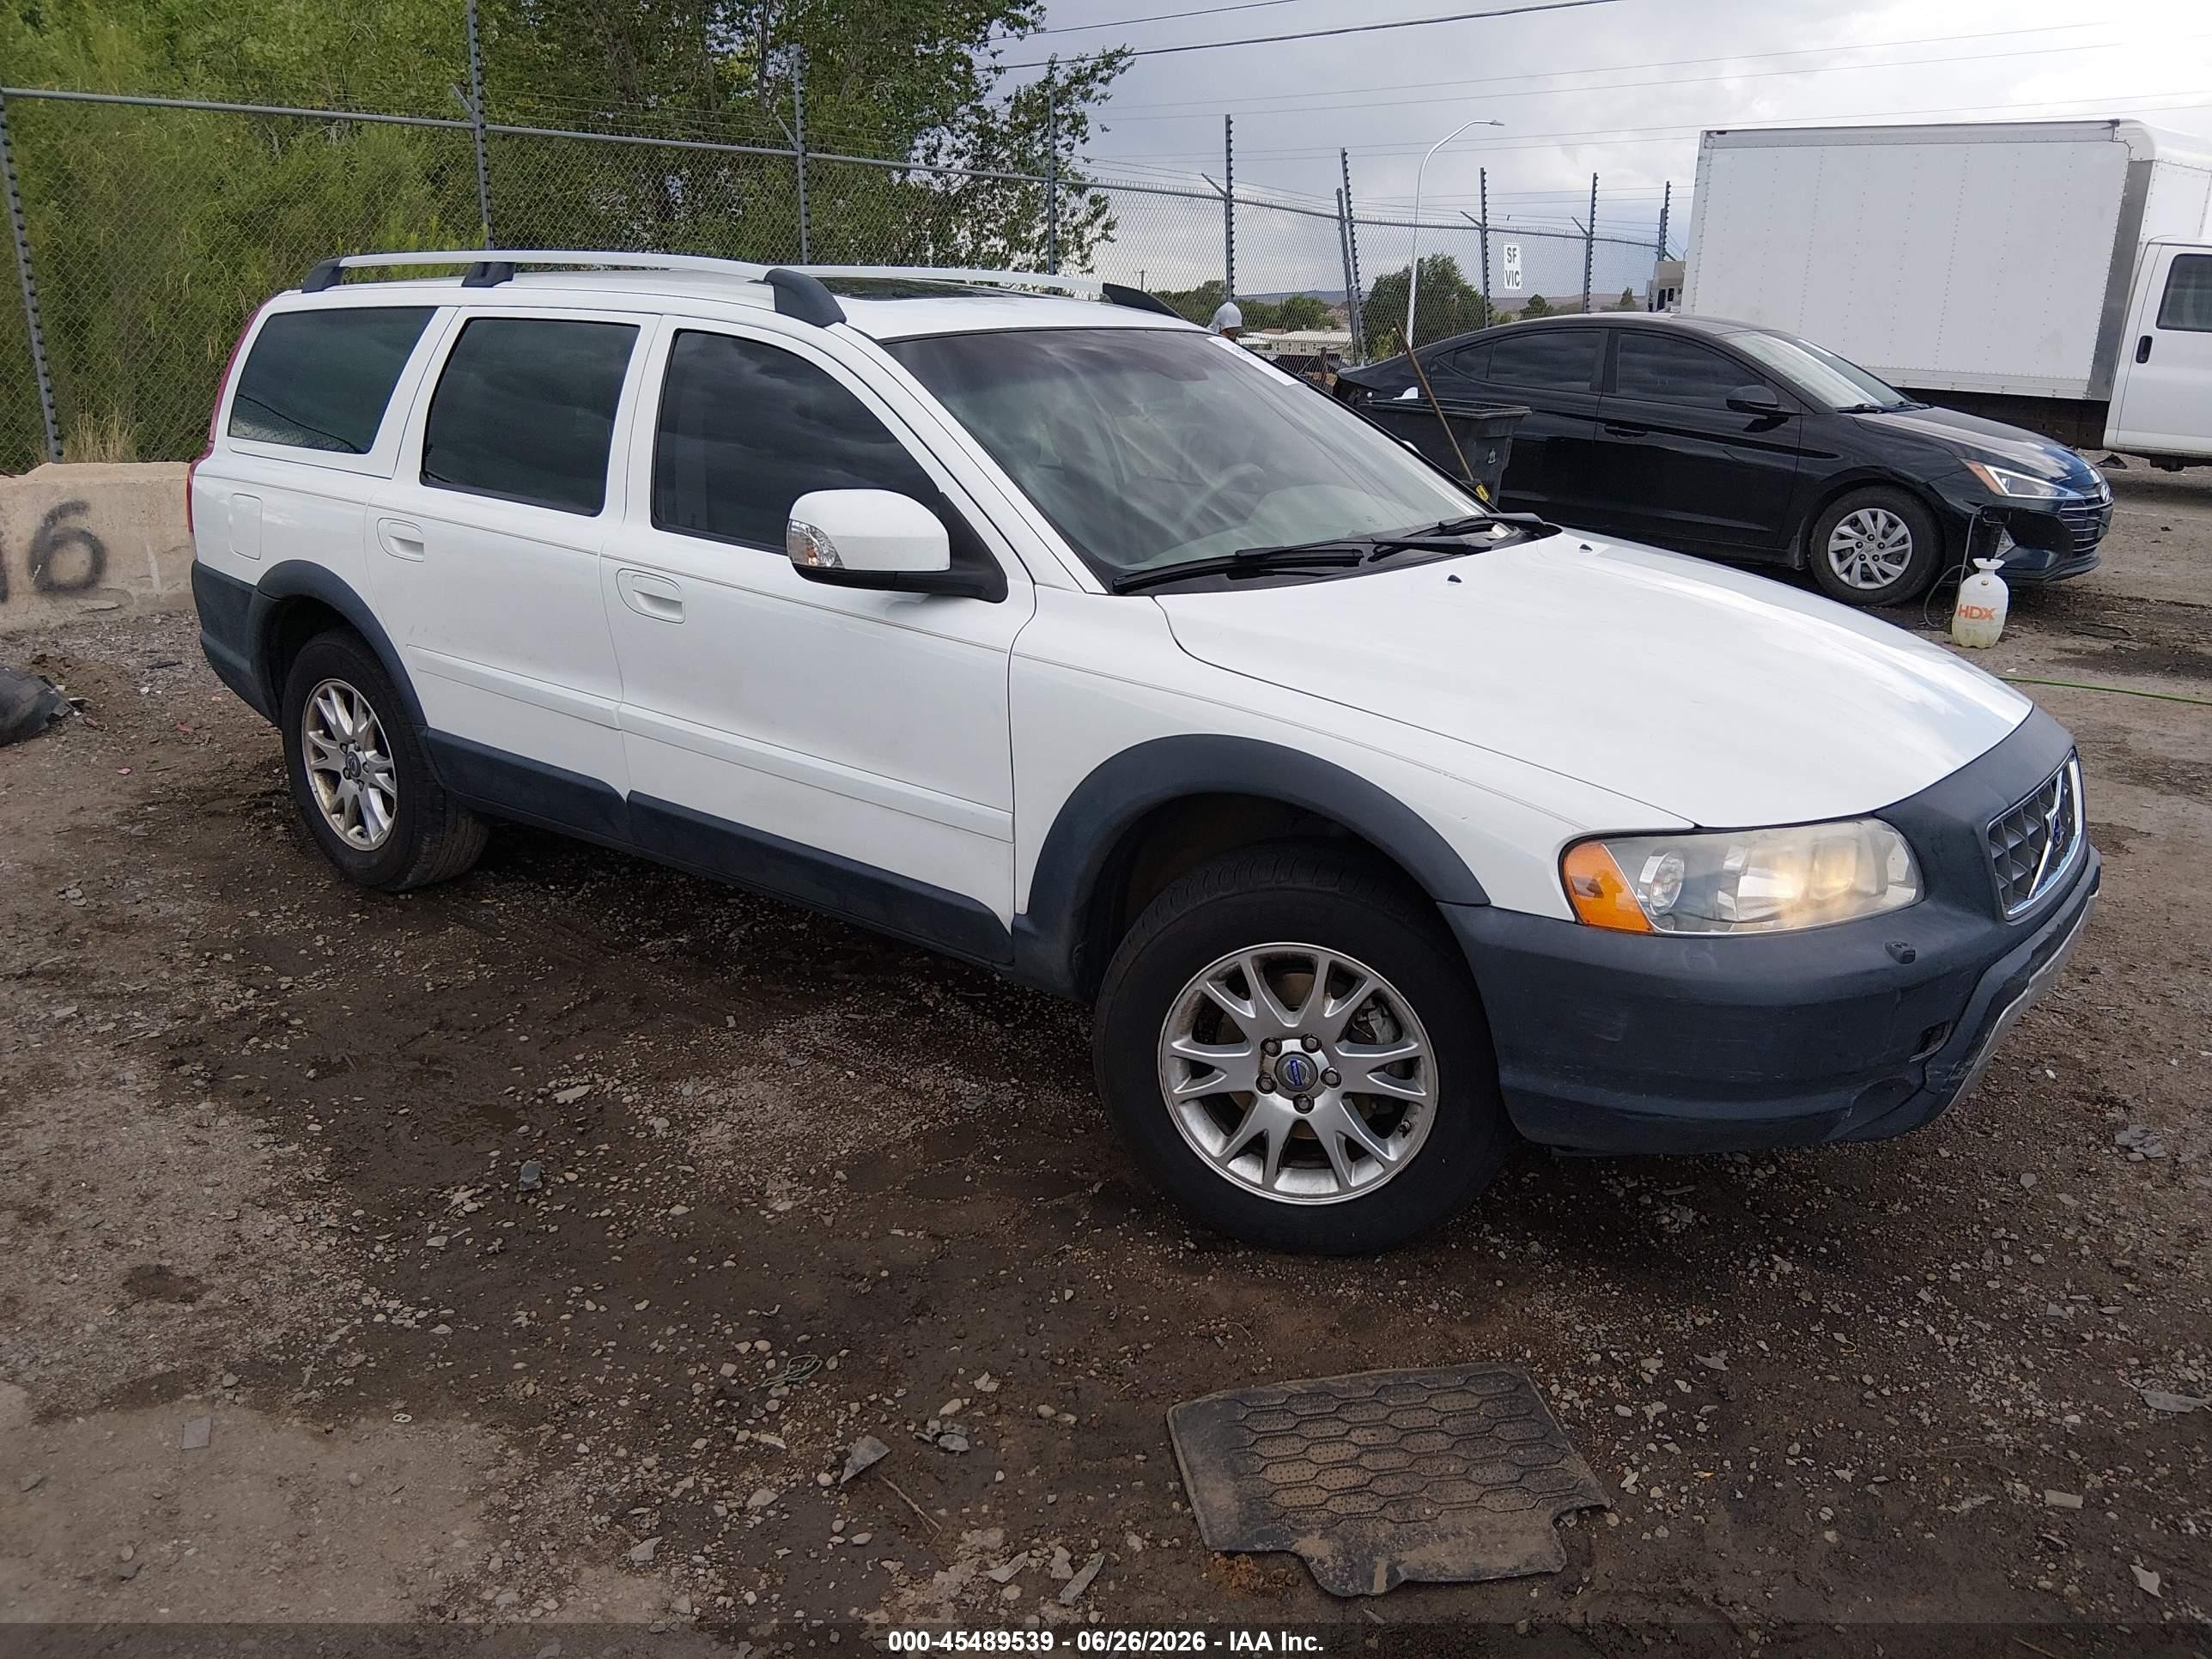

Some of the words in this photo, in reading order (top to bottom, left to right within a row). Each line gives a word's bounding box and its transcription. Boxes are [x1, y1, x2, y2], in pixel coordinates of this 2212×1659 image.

[1506, 246, 1517, 264] SF
[1504, 270, 1521, 287] VIC
[0, 500, 106, 603] 6
[1958, 604, 1997, 620] HDX
